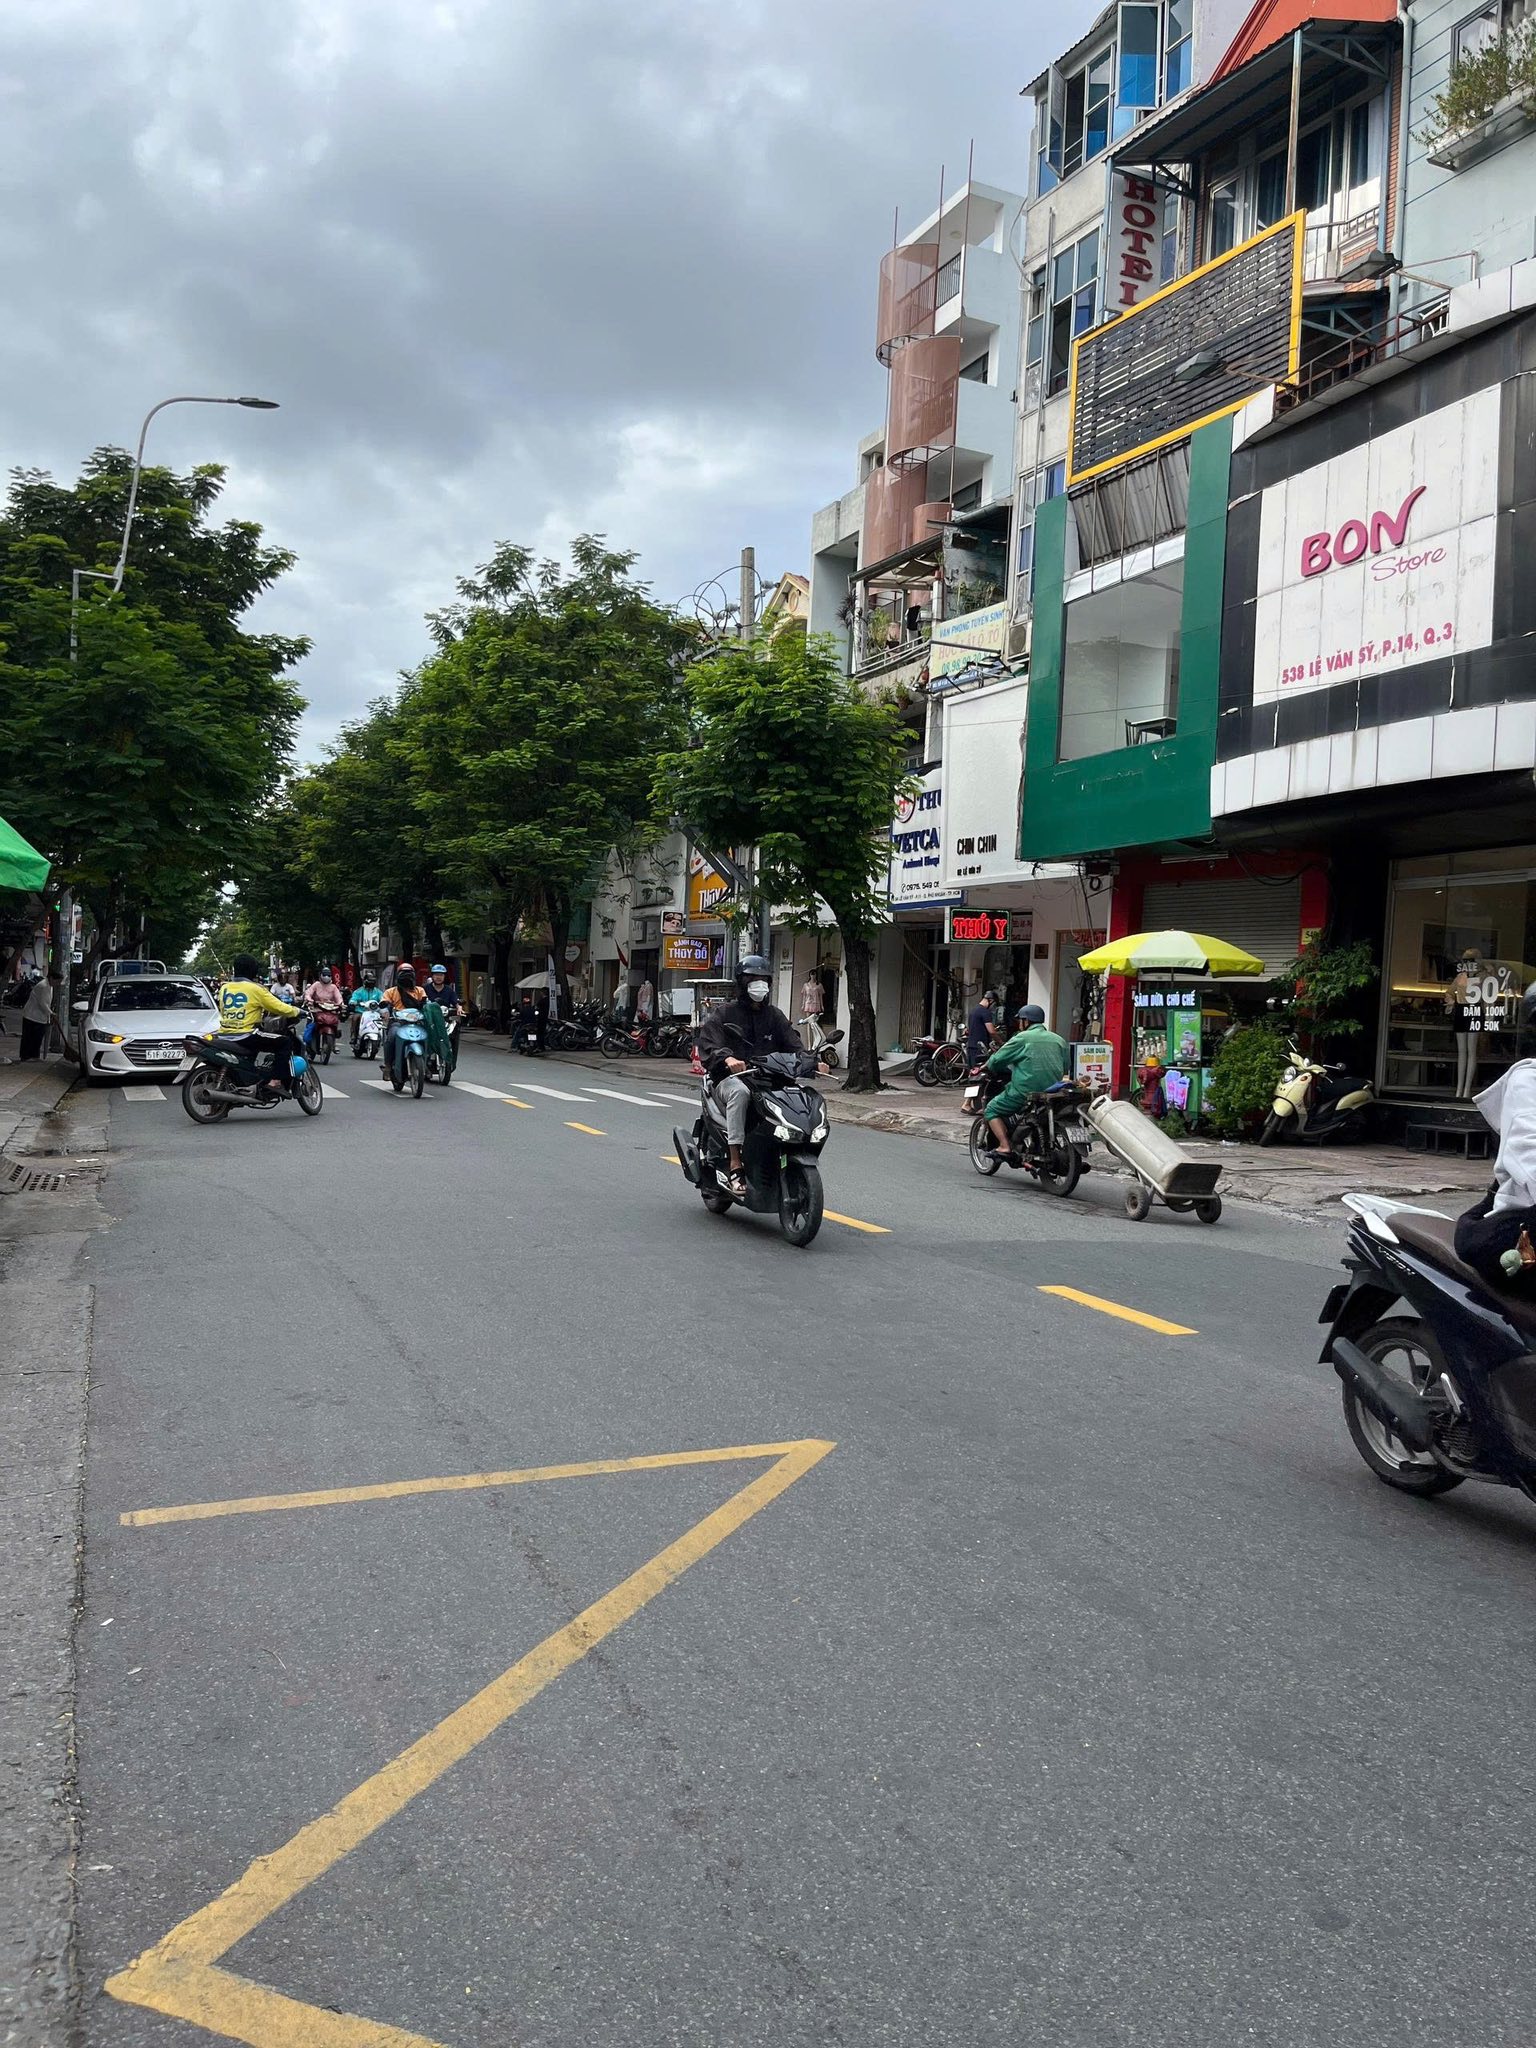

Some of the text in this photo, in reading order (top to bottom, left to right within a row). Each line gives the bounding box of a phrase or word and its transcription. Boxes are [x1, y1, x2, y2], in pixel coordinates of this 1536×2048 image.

[1301, 485, 1427, 578] BON
[1371, 547, 1447, 582] Store
[1281, 664, 1305, 685] 538
[1308, 655, 1322, 678] LÊ
[1326, 647, 1353, 673] VĂN
[1423, 622, 1453, 646] Q.3
[892, 826, 941, 854] VETCA
[953, 912, 991, 939] THÚ
[994, 918, 1008, 940] Y
[1456, 962, 1478, 972] SALE
[222, 987, 248, 1009] be
[1465, 967, 1512, 1004] 50%
[1469, 1017, 1500, 1031] ÁO 50K
[1485, 1006, 1505, 1017] 100K
